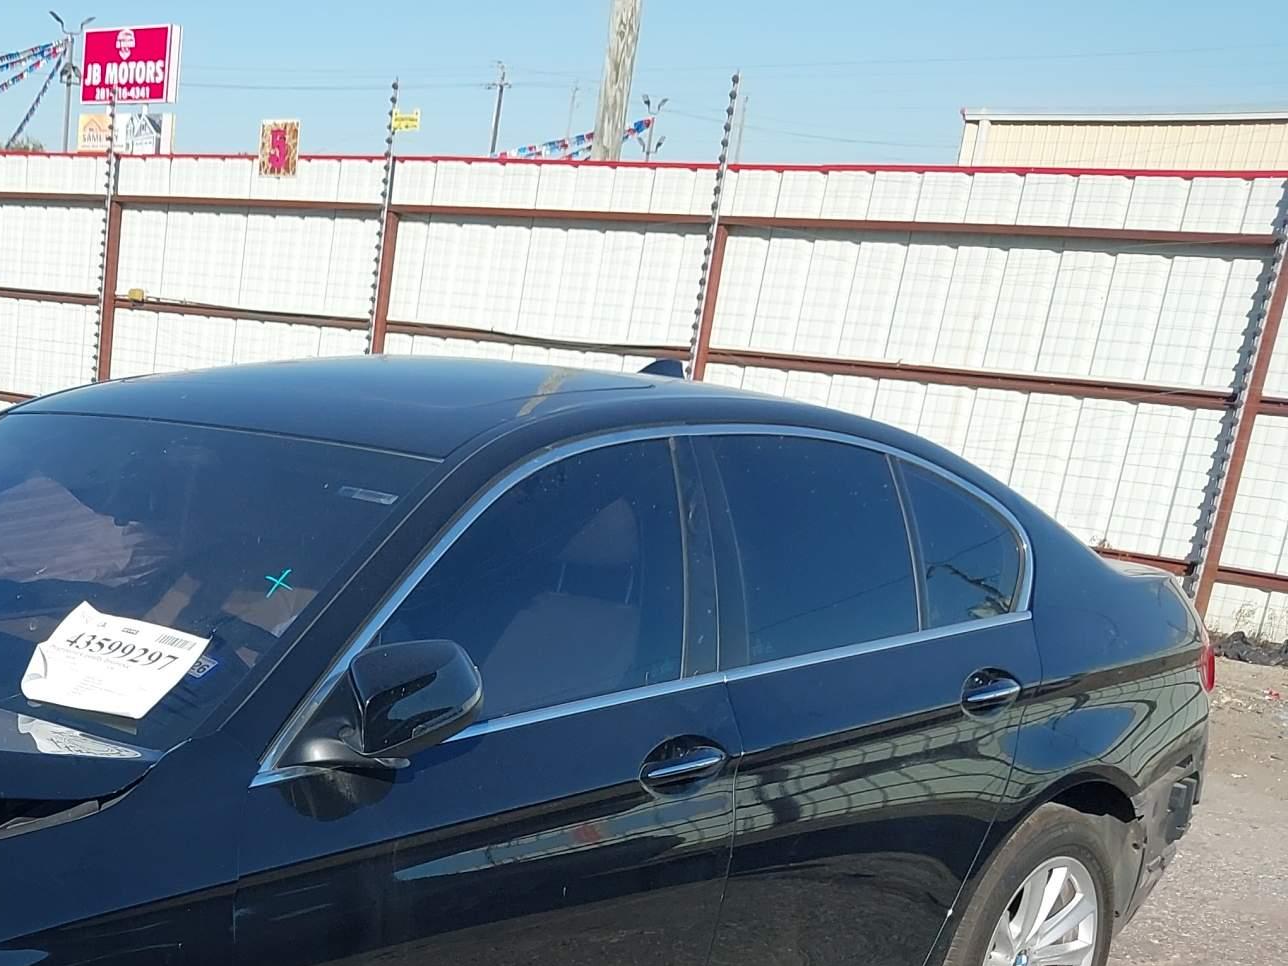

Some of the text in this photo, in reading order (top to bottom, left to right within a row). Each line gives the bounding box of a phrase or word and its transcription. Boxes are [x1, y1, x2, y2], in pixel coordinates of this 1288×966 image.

[84, 59, 165, 86] JB MOTORS
[66, 632, 179, 671] 43599297
[191, 660, 210, 674] 26
